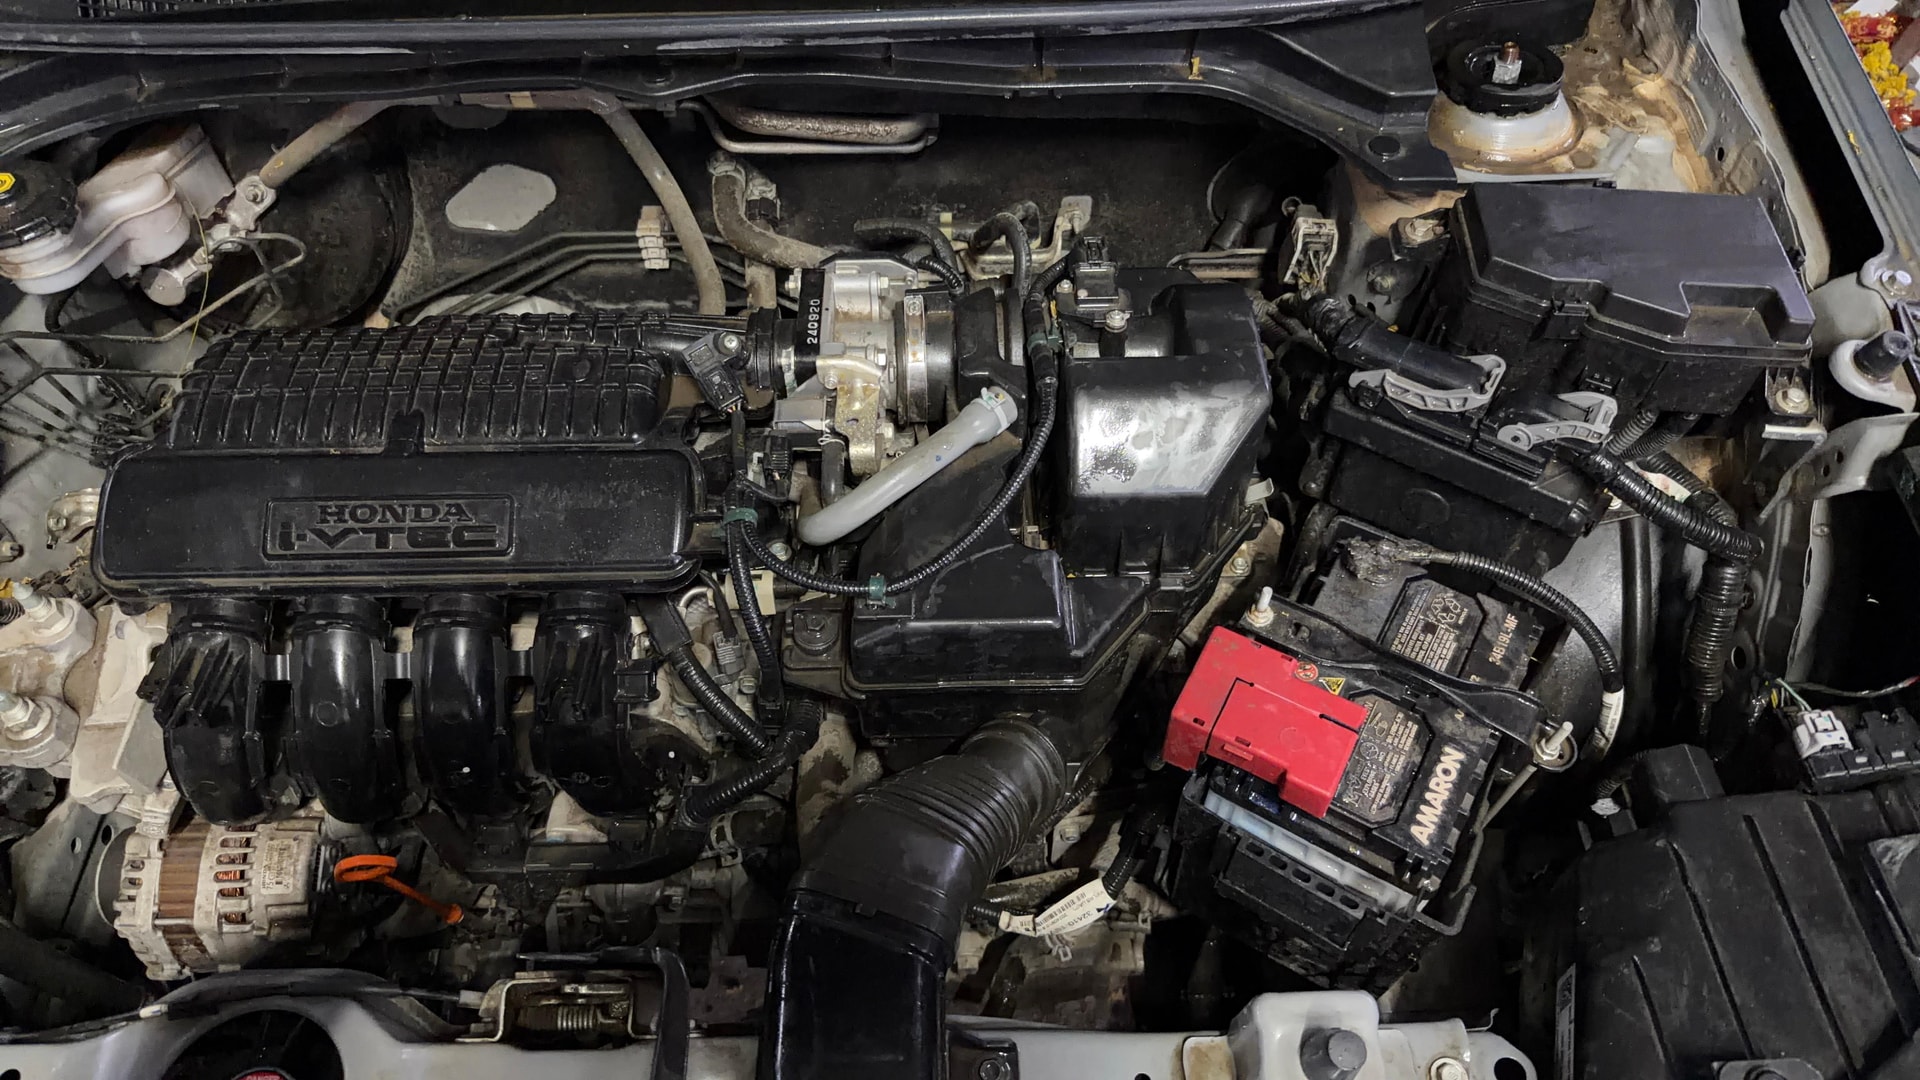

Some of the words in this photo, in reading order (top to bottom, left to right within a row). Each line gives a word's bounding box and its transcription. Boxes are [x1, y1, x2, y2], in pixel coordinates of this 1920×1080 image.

[806, 298, 821, 345] 240920
[315, 503, 475, 525] HONDA
[1410, 746, 1466, 846] AMARON
